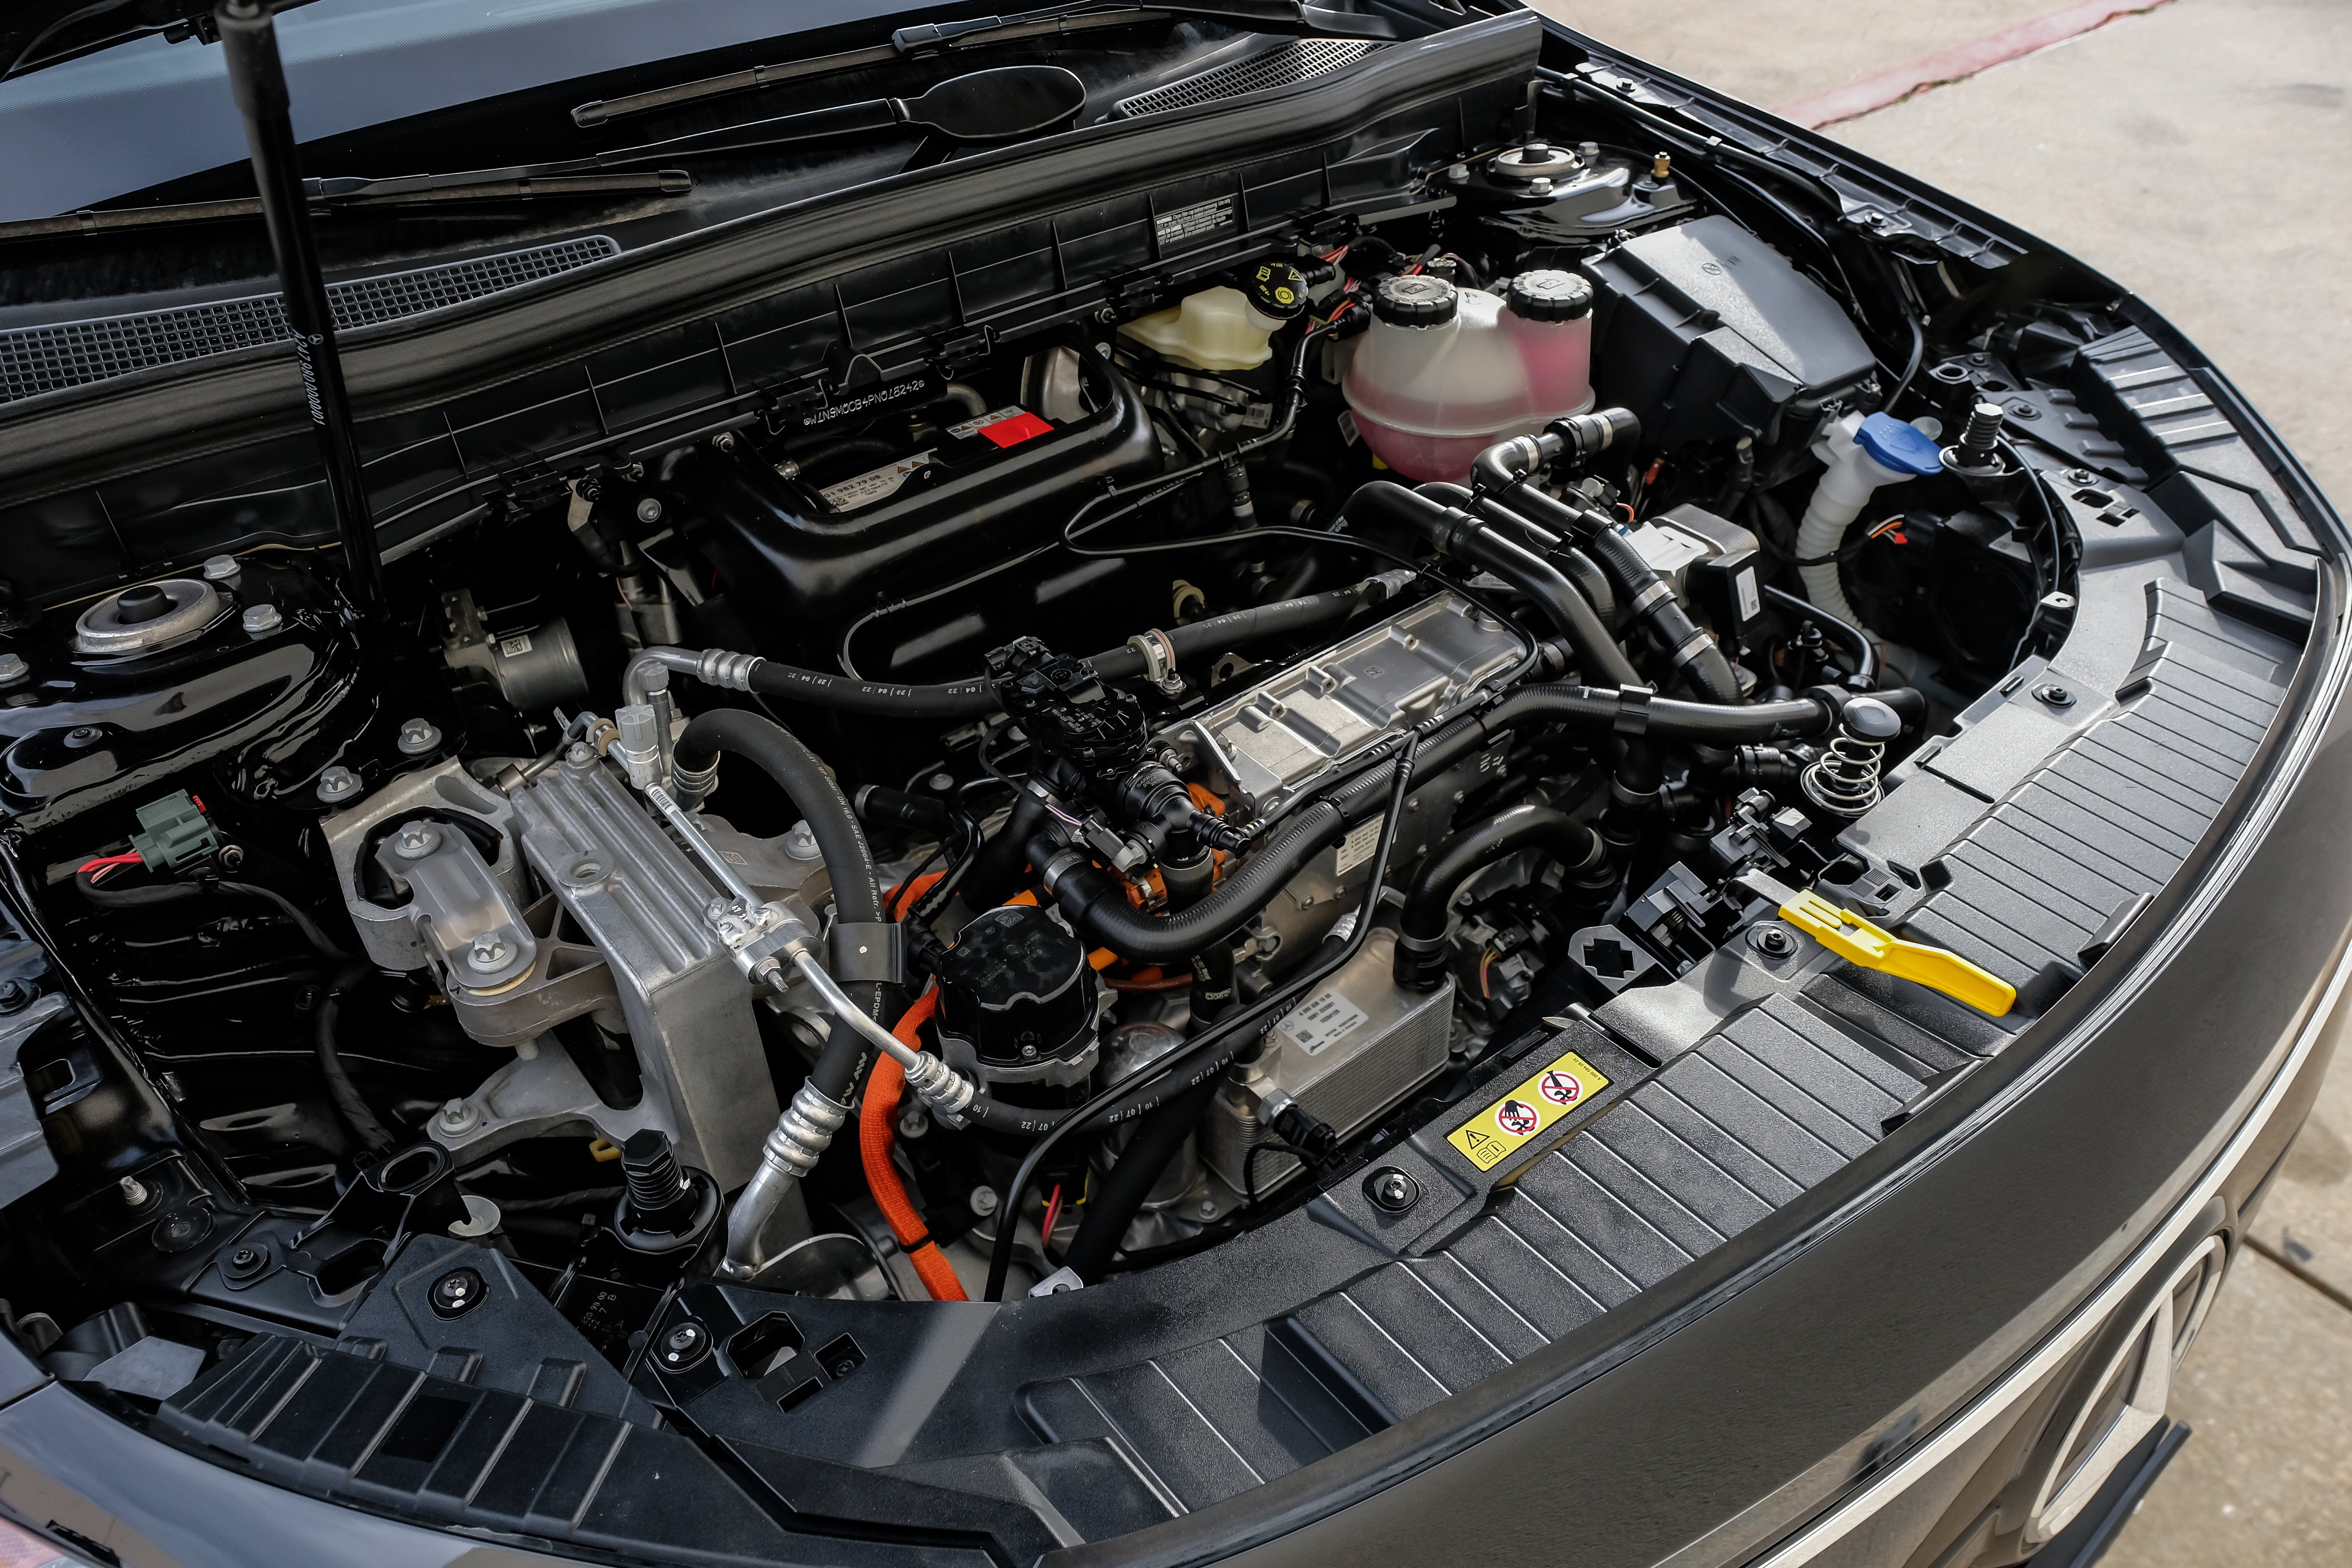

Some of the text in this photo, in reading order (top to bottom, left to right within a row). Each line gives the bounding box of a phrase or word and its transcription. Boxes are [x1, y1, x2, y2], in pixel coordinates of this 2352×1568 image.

[851, 825, 862, 839] SAE
[1271, 1015, 1281, 1024] 07
[1205, 1067, 1215, 1076] 07
[1190, 1076, 1201, 1086] 22
[972, 1104, 982, 1114] 10
[1108, 1101, 1154, 1123] 10 07 22
[1021, 1121, 1049, 1132] 07 22
[590, 1302, 600, 1310] 98
